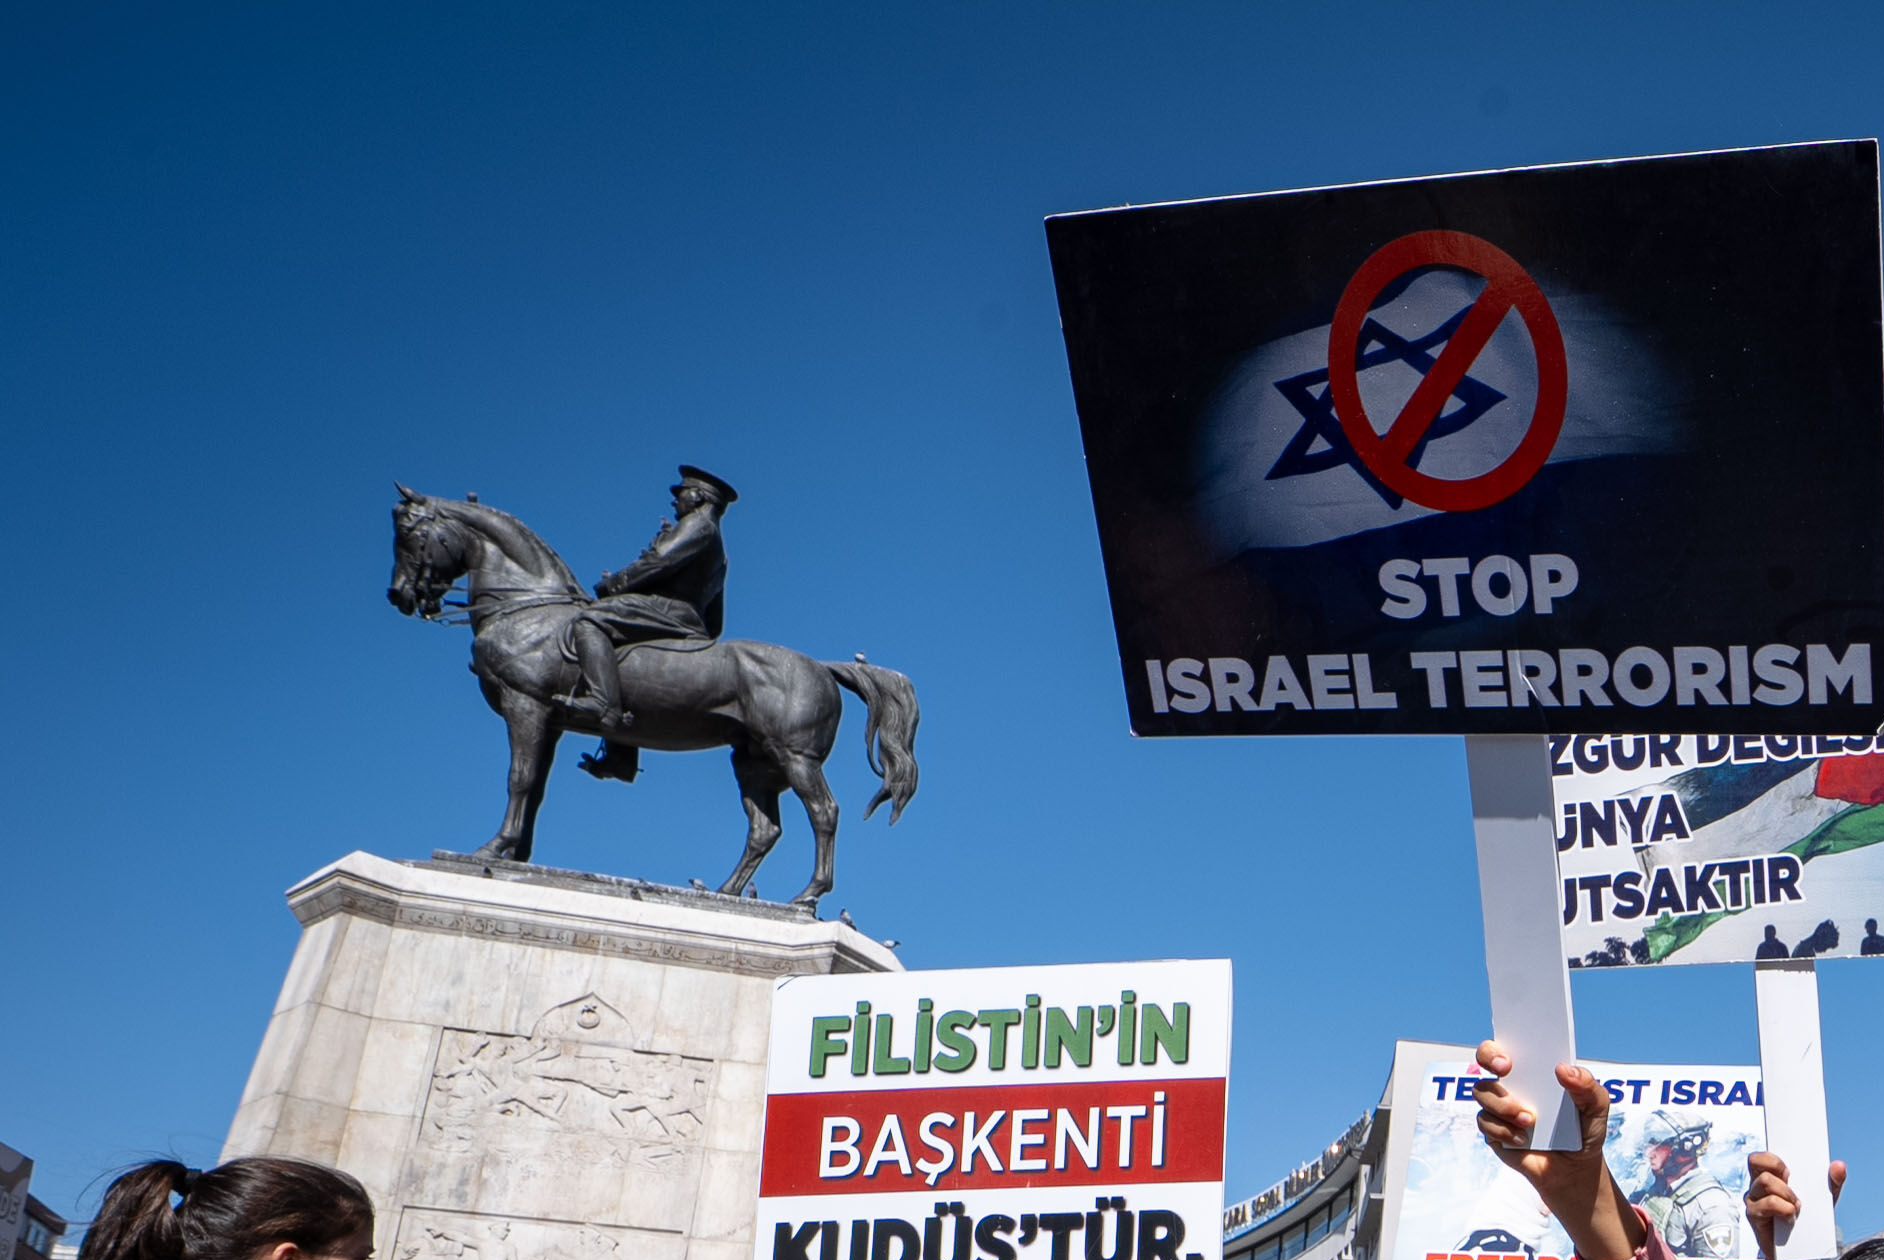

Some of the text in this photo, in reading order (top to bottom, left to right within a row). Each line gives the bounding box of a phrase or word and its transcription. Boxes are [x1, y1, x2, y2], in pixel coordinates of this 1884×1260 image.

[1377, 553, 1579, 619] STOP
[1144, 643, 1873, 714] ISRAEL TERRORISM
[1557, 793, 1691, 852] ÜNYA
[1563, 855, 1803, 926] TSAKTIR
[819, 1091, 1166, 1186] BAŞKENTİ
